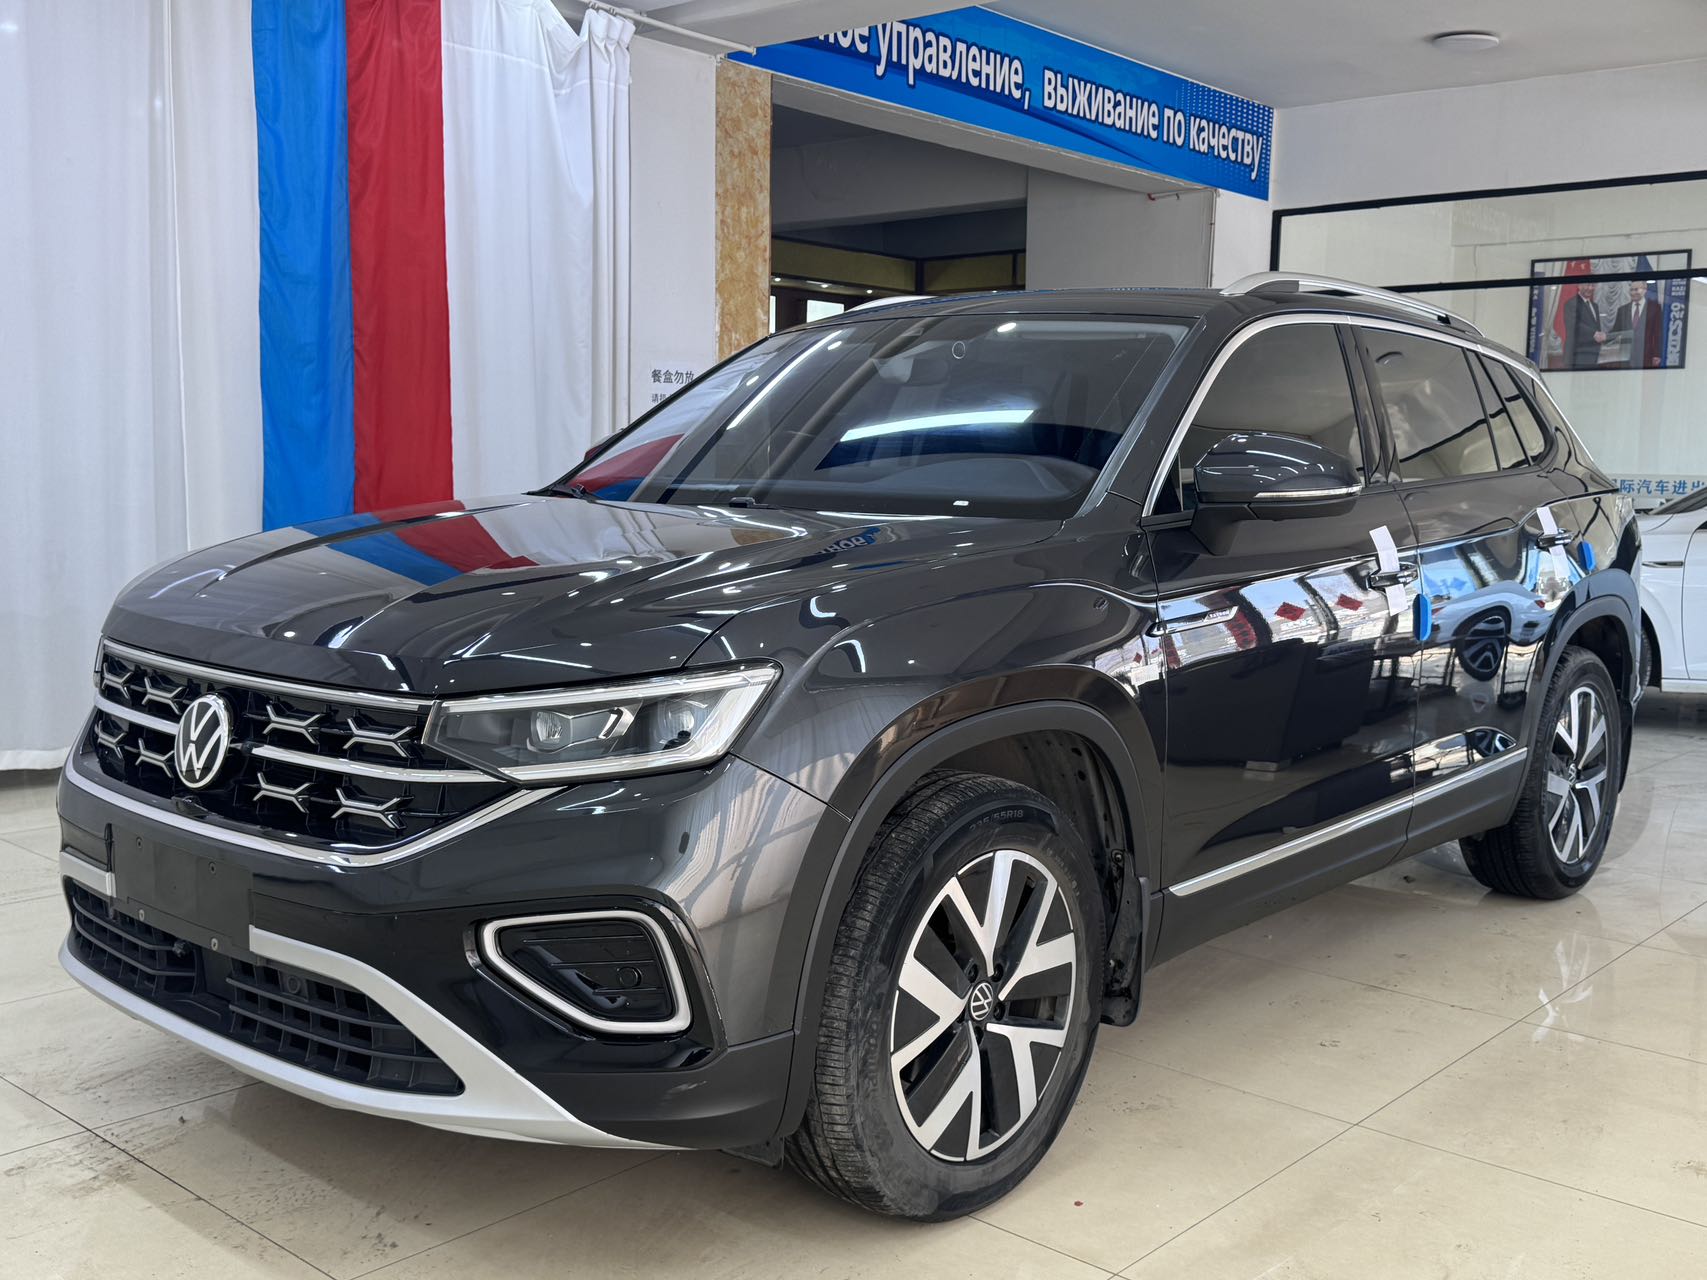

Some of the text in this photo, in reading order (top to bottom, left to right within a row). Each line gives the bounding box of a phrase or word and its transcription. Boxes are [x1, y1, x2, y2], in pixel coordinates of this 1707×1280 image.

[875, 21, 1030, 110] управление,
[1043, 69, 1159, 139] выживание
[1163, 107, 1186, 147] по
[1189, 116, 1263, 181] качеству
